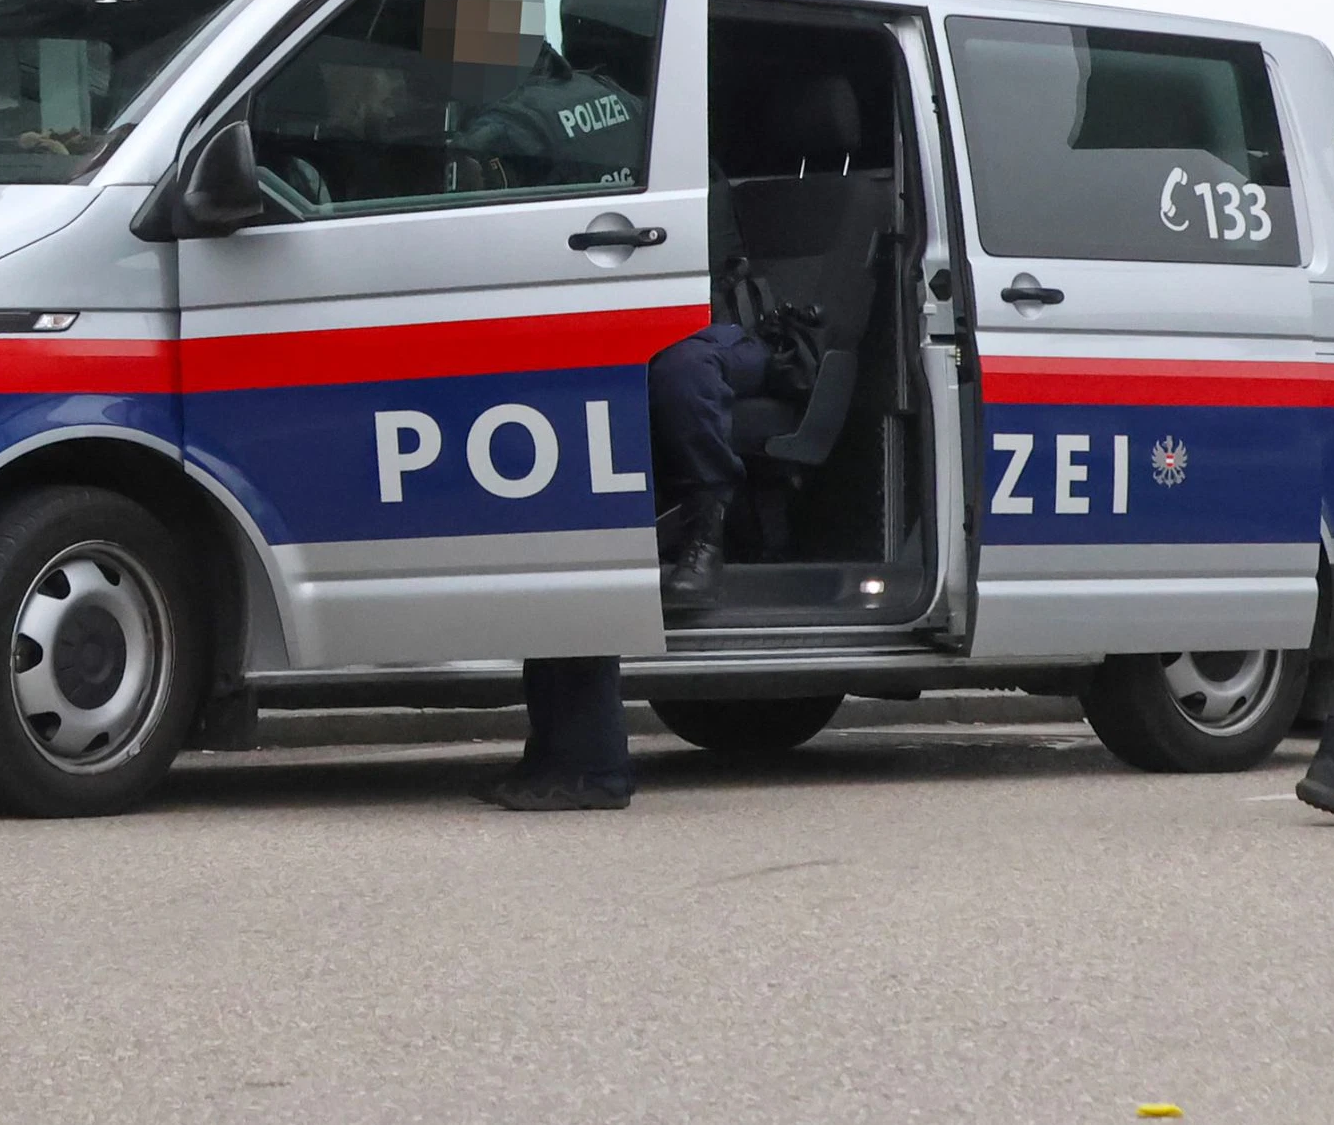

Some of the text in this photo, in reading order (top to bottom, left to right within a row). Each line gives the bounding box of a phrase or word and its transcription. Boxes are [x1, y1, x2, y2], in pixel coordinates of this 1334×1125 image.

[558, 94, 630, 138] POLIZEI
[1194, 182, 1272, 241] 133
[375, 400, 1129, 515] POL ZEI
